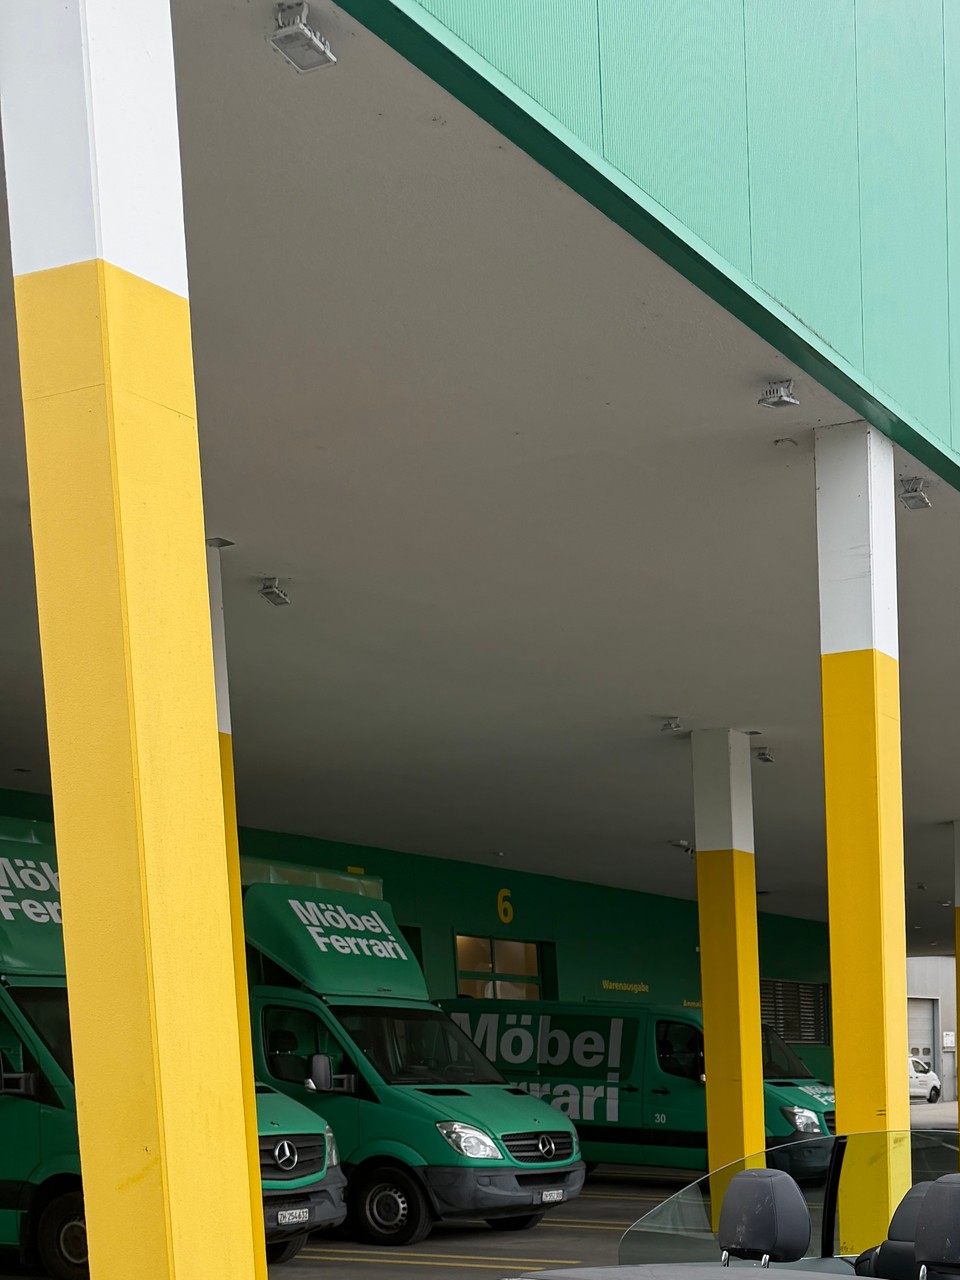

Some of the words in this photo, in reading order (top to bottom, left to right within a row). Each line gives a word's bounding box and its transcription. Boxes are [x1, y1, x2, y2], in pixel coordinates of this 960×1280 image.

[287, 899, 391, 935] Möbel
[496, 887, 514, 924] 6
[305, 925, 408, 961] Ferrari
[601, 979, 650, 994] Warenausgabe
[447, 1012, 624, 1068] Möbel
[654, 1113, 667, 1125] 30
